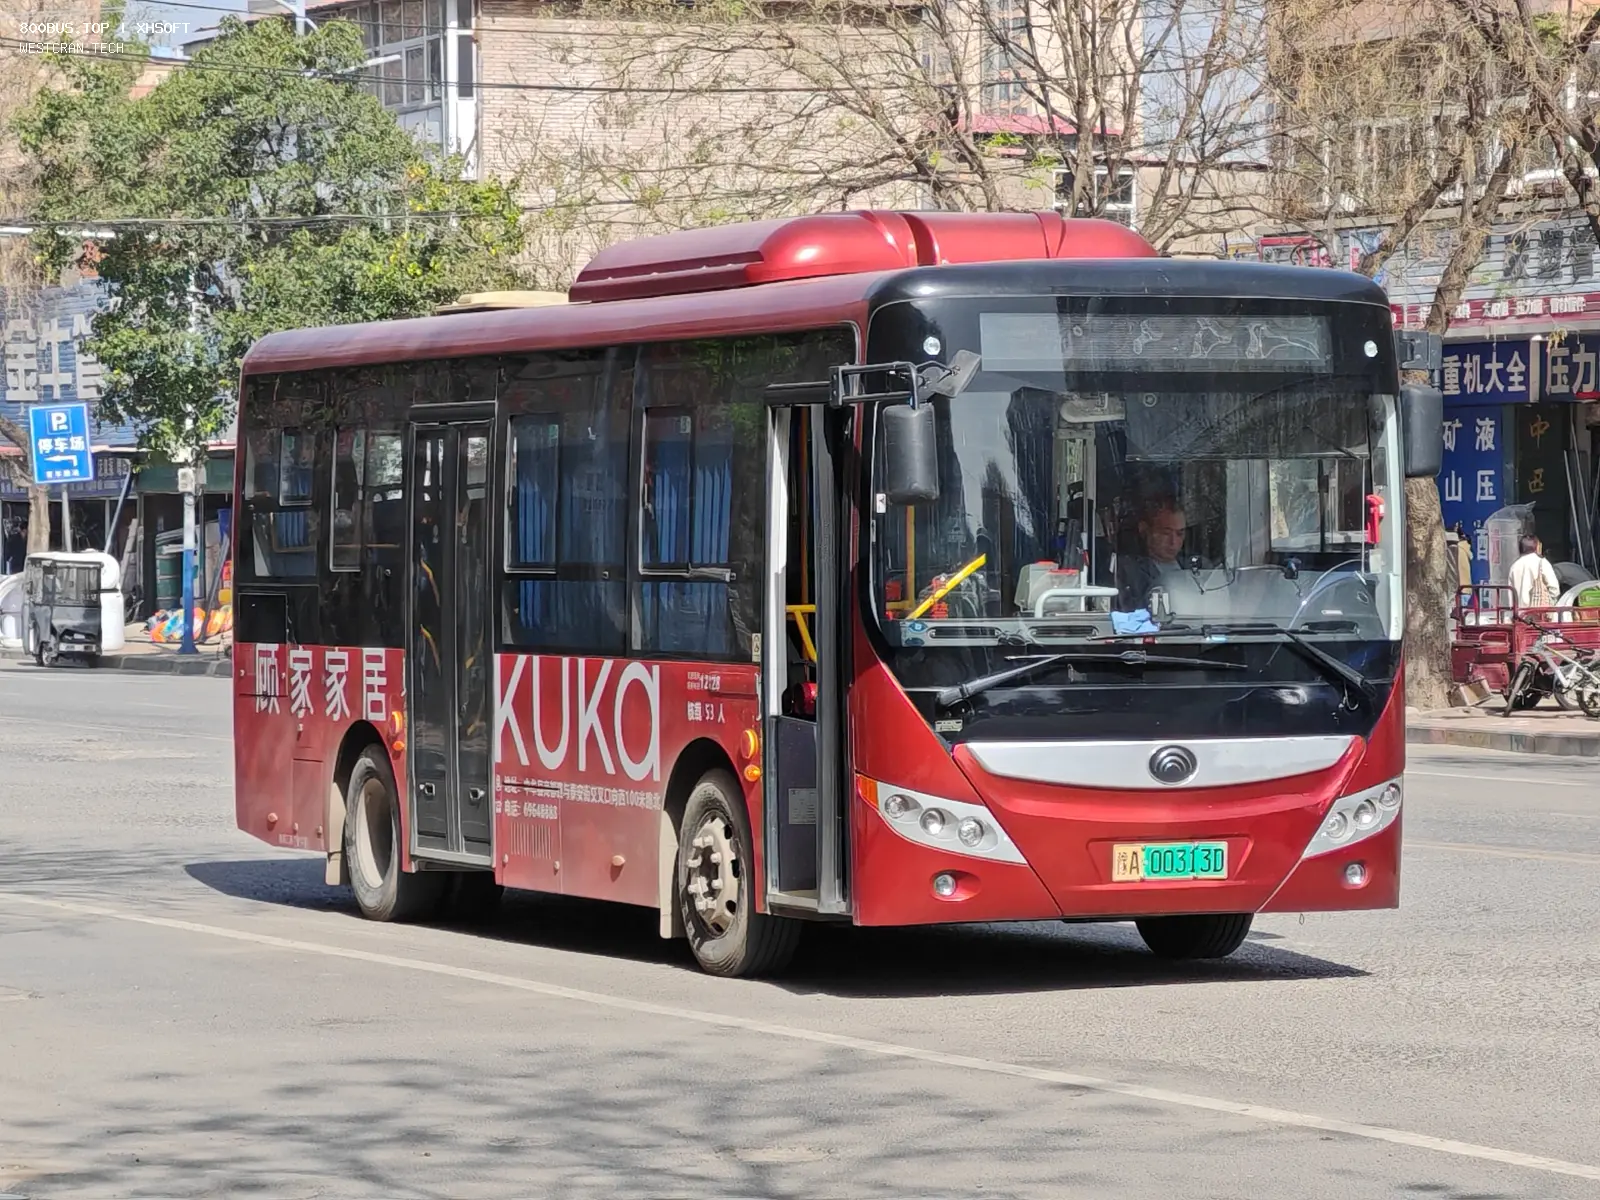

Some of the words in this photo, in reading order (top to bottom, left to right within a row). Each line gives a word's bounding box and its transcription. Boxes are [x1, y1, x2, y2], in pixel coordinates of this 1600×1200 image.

[1442, 350, 1527, 396] 重机大全
[38, 436, 85, 454] 停车场
[256, 643, 387, 722] 顾家家居
[717, 703, 725, 723] 人
